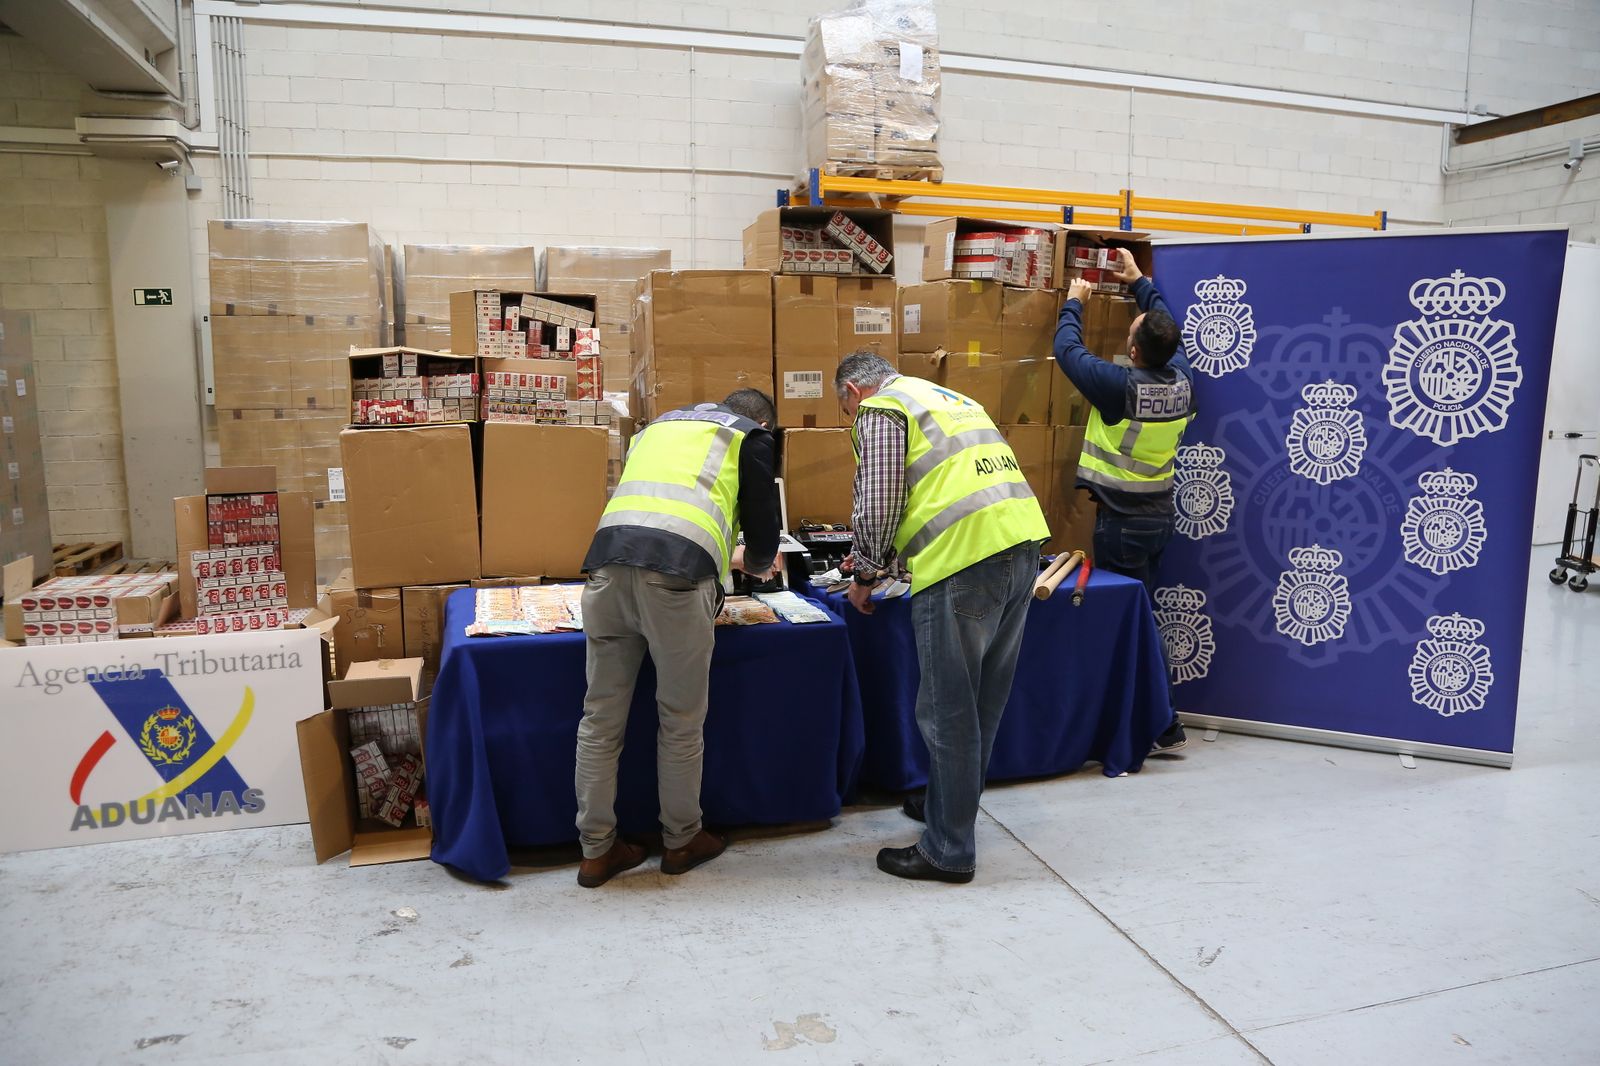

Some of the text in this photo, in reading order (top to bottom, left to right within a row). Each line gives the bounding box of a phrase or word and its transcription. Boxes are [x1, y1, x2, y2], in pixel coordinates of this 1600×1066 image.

[1414, 341, 1490, 370] CUERPO NACIONAL DE
[1141, 387, 1168, 397] CUERPO
[1432, 402, 1464, 411] POLICIA
[1254, 464, 1291, 506] CUER
[1384, 494, 1399, 515] DE
[15, 645, 304, 695] Agencia Tributaria
[70, 788, 266, 832] ADUANAS
